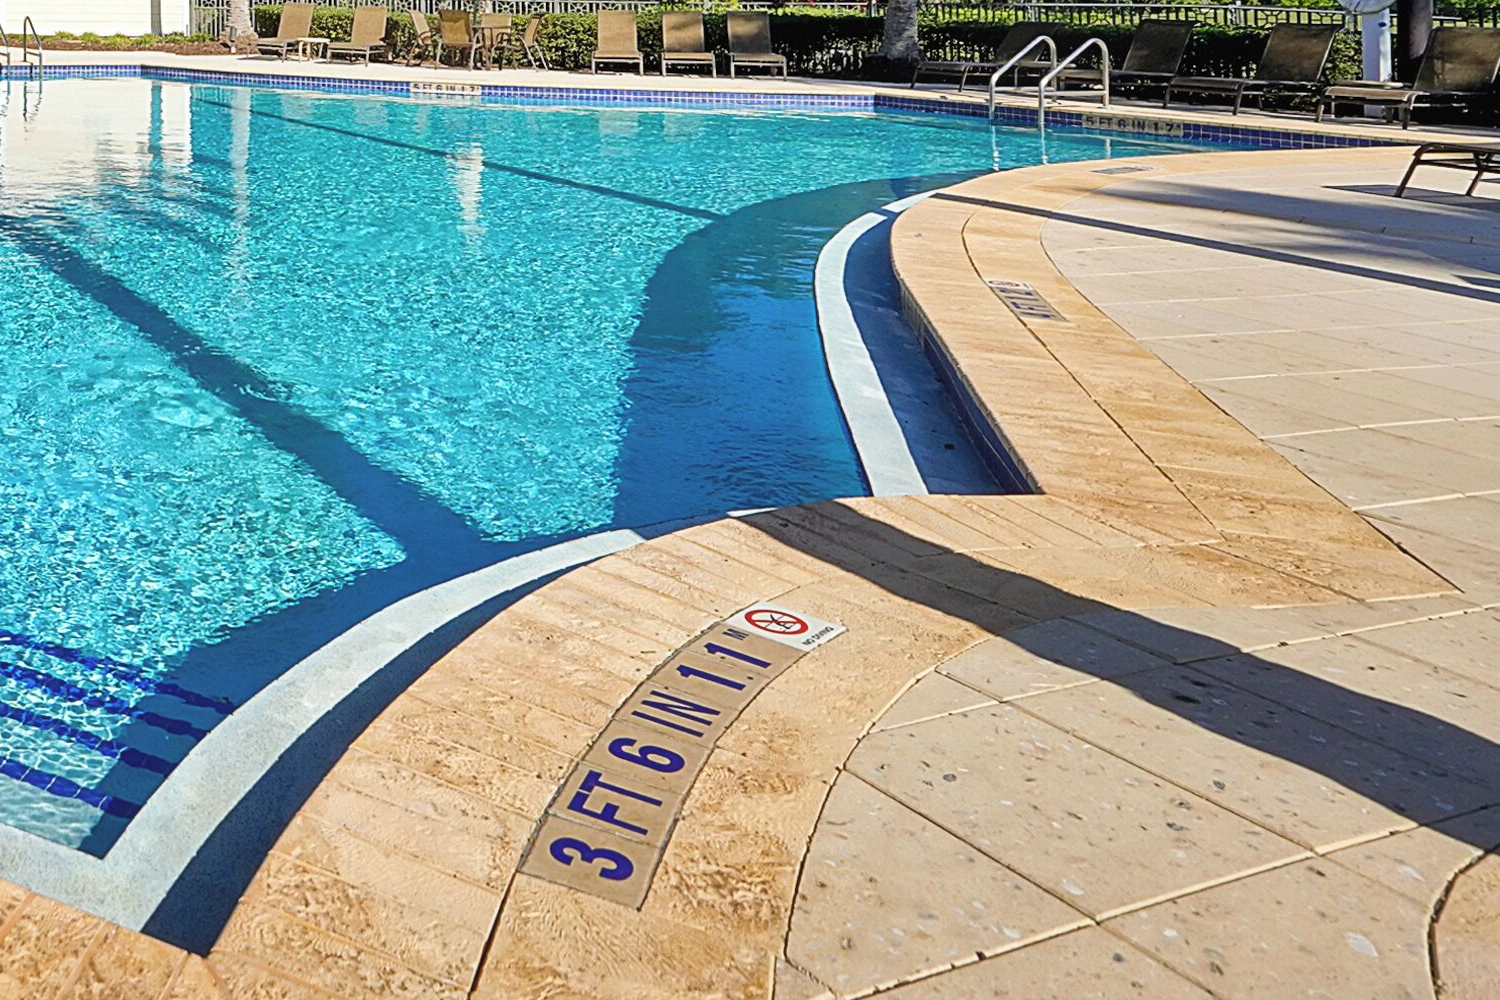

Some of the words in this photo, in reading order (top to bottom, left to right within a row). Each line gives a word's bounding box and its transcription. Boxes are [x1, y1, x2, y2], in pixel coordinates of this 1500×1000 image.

[1099, 117, 1112, 126] FT
[1132, 120, 1146, 130] IN
[631, 690, 721, 738] IN
[608, 737, 685, 774] 6
[567, 769, 662, 835] FT
[549, 836, 634, 882] 3
